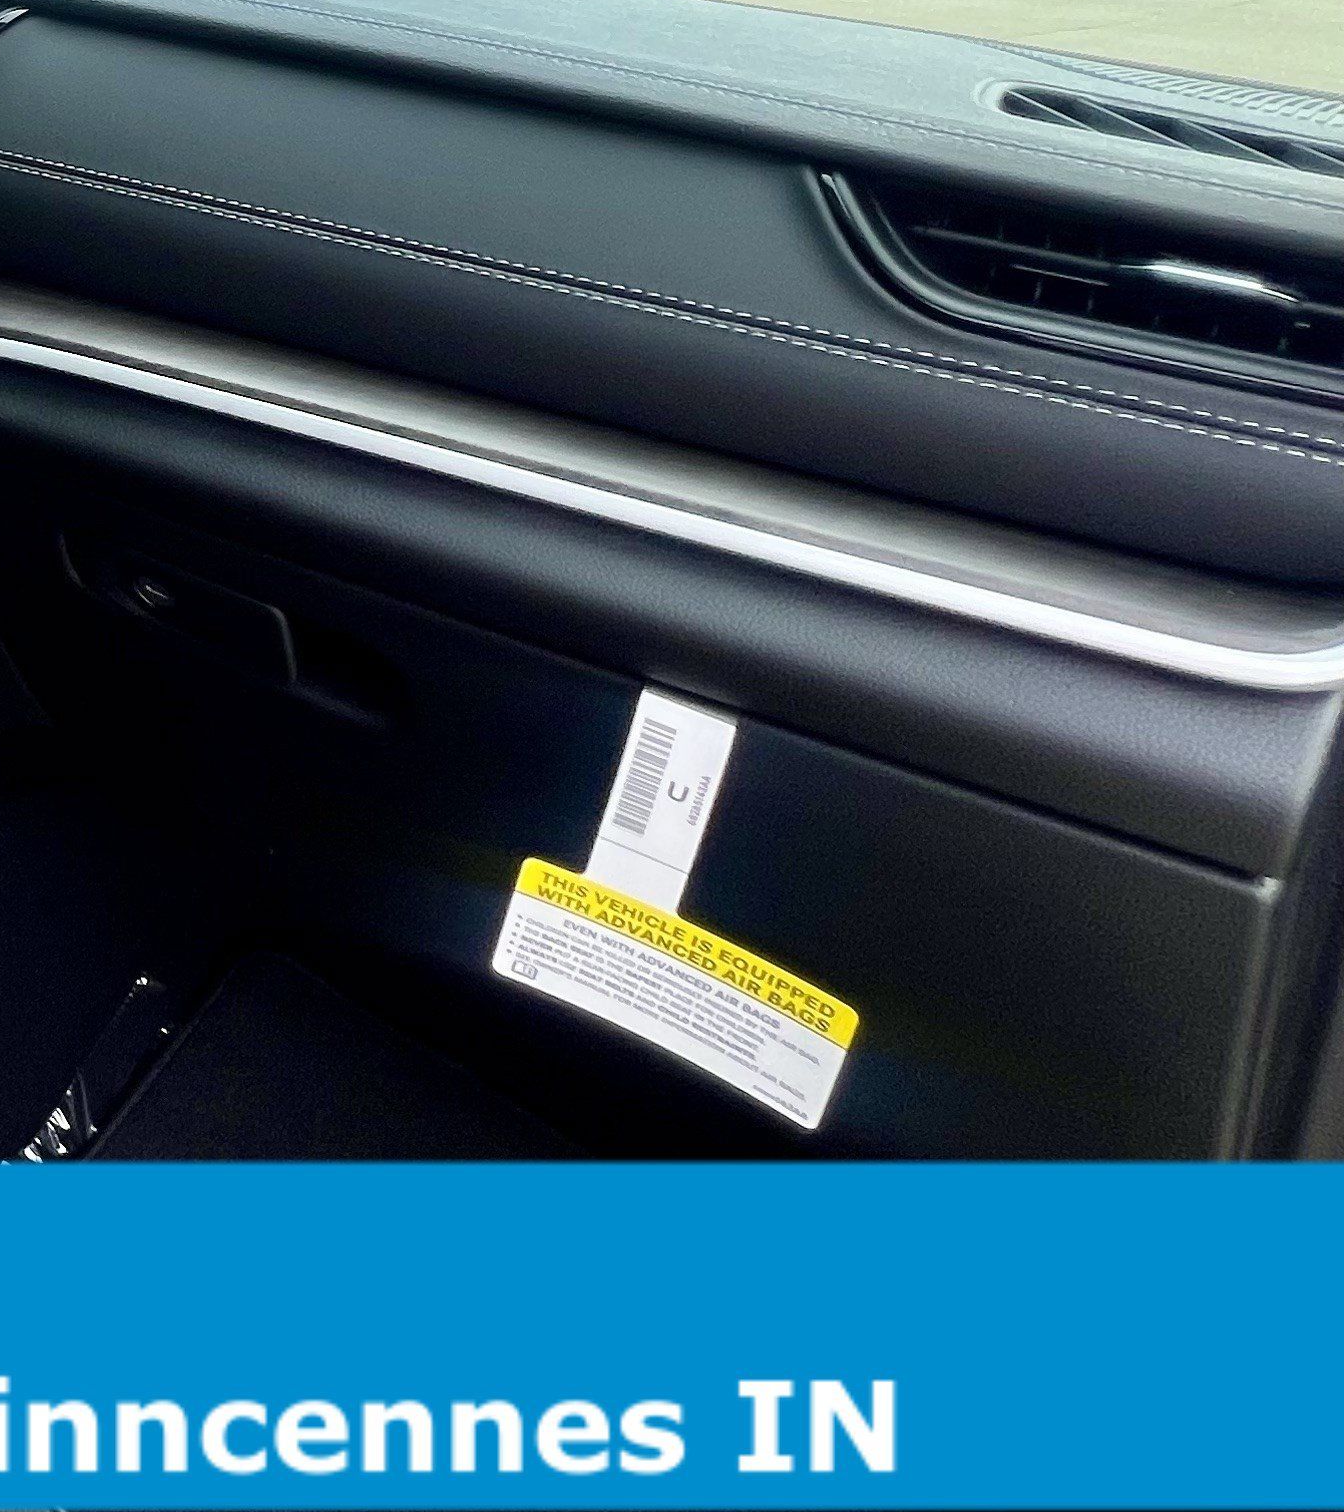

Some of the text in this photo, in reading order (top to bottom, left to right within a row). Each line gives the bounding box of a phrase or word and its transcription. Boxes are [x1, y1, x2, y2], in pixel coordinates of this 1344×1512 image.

[537, 885, 591, 914] WITH
[595, 910, 717, 972] ADVANCED
[722, 969, 762, 997] AIR
[767, 992, 831, 1033] BAGS
[542, 871, 589, 898] THIS
[595, 891, 687, 940] VEHICLE
[690, 935, 713, 954] IS
[718, 949, 835, 1019] EQUIPPED
[563, 919, 599, 939] EVEN
[601, 935, 635, 956] WITH
[637, 953, 712, 992] ADVANCED
[714, 990, 740, 1007] AIR
[742, 1003, 781, 1029] BAGS
